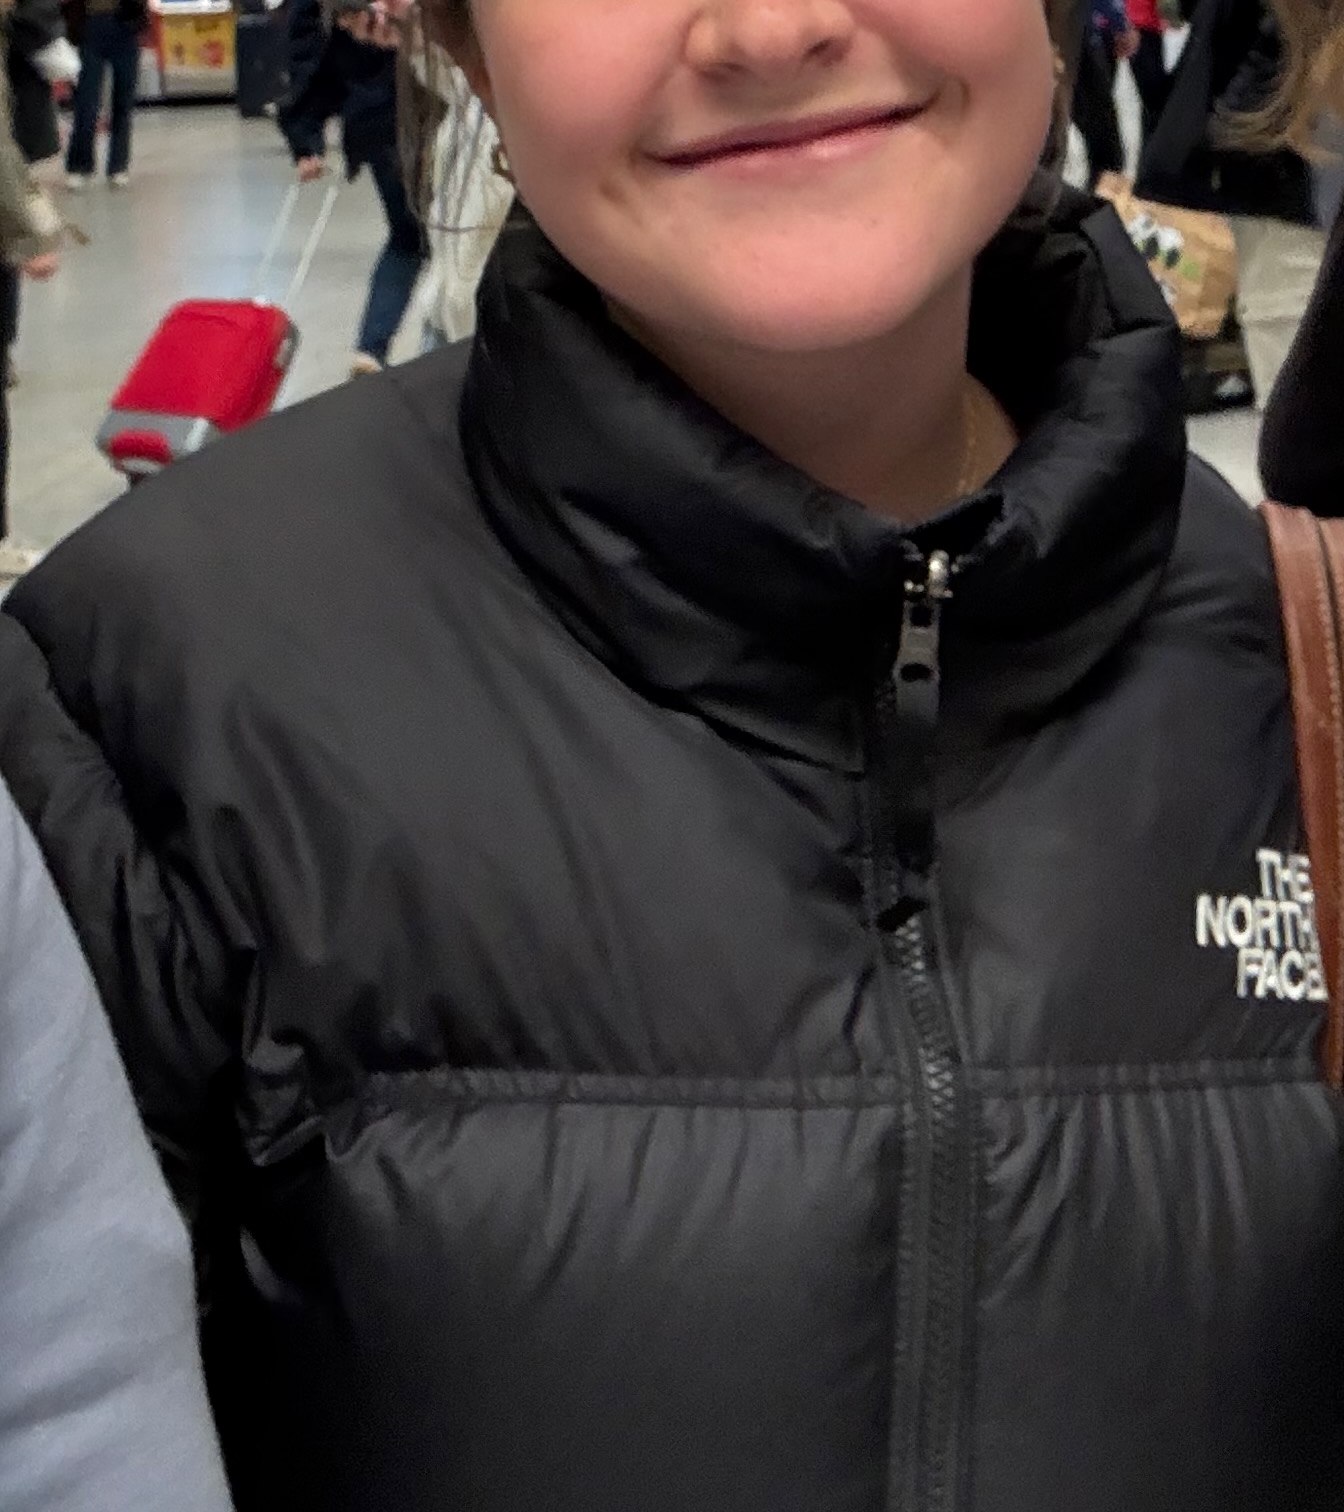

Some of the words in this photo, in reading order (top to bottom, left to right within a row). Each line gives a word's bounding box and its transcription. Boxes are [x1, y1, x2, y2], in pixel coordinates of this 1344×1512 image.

[1257, 848, 1314, 903] THE
[1196, 894, 1320, 951] NORTH
[1237, 947, 1328, 1000] FACE
